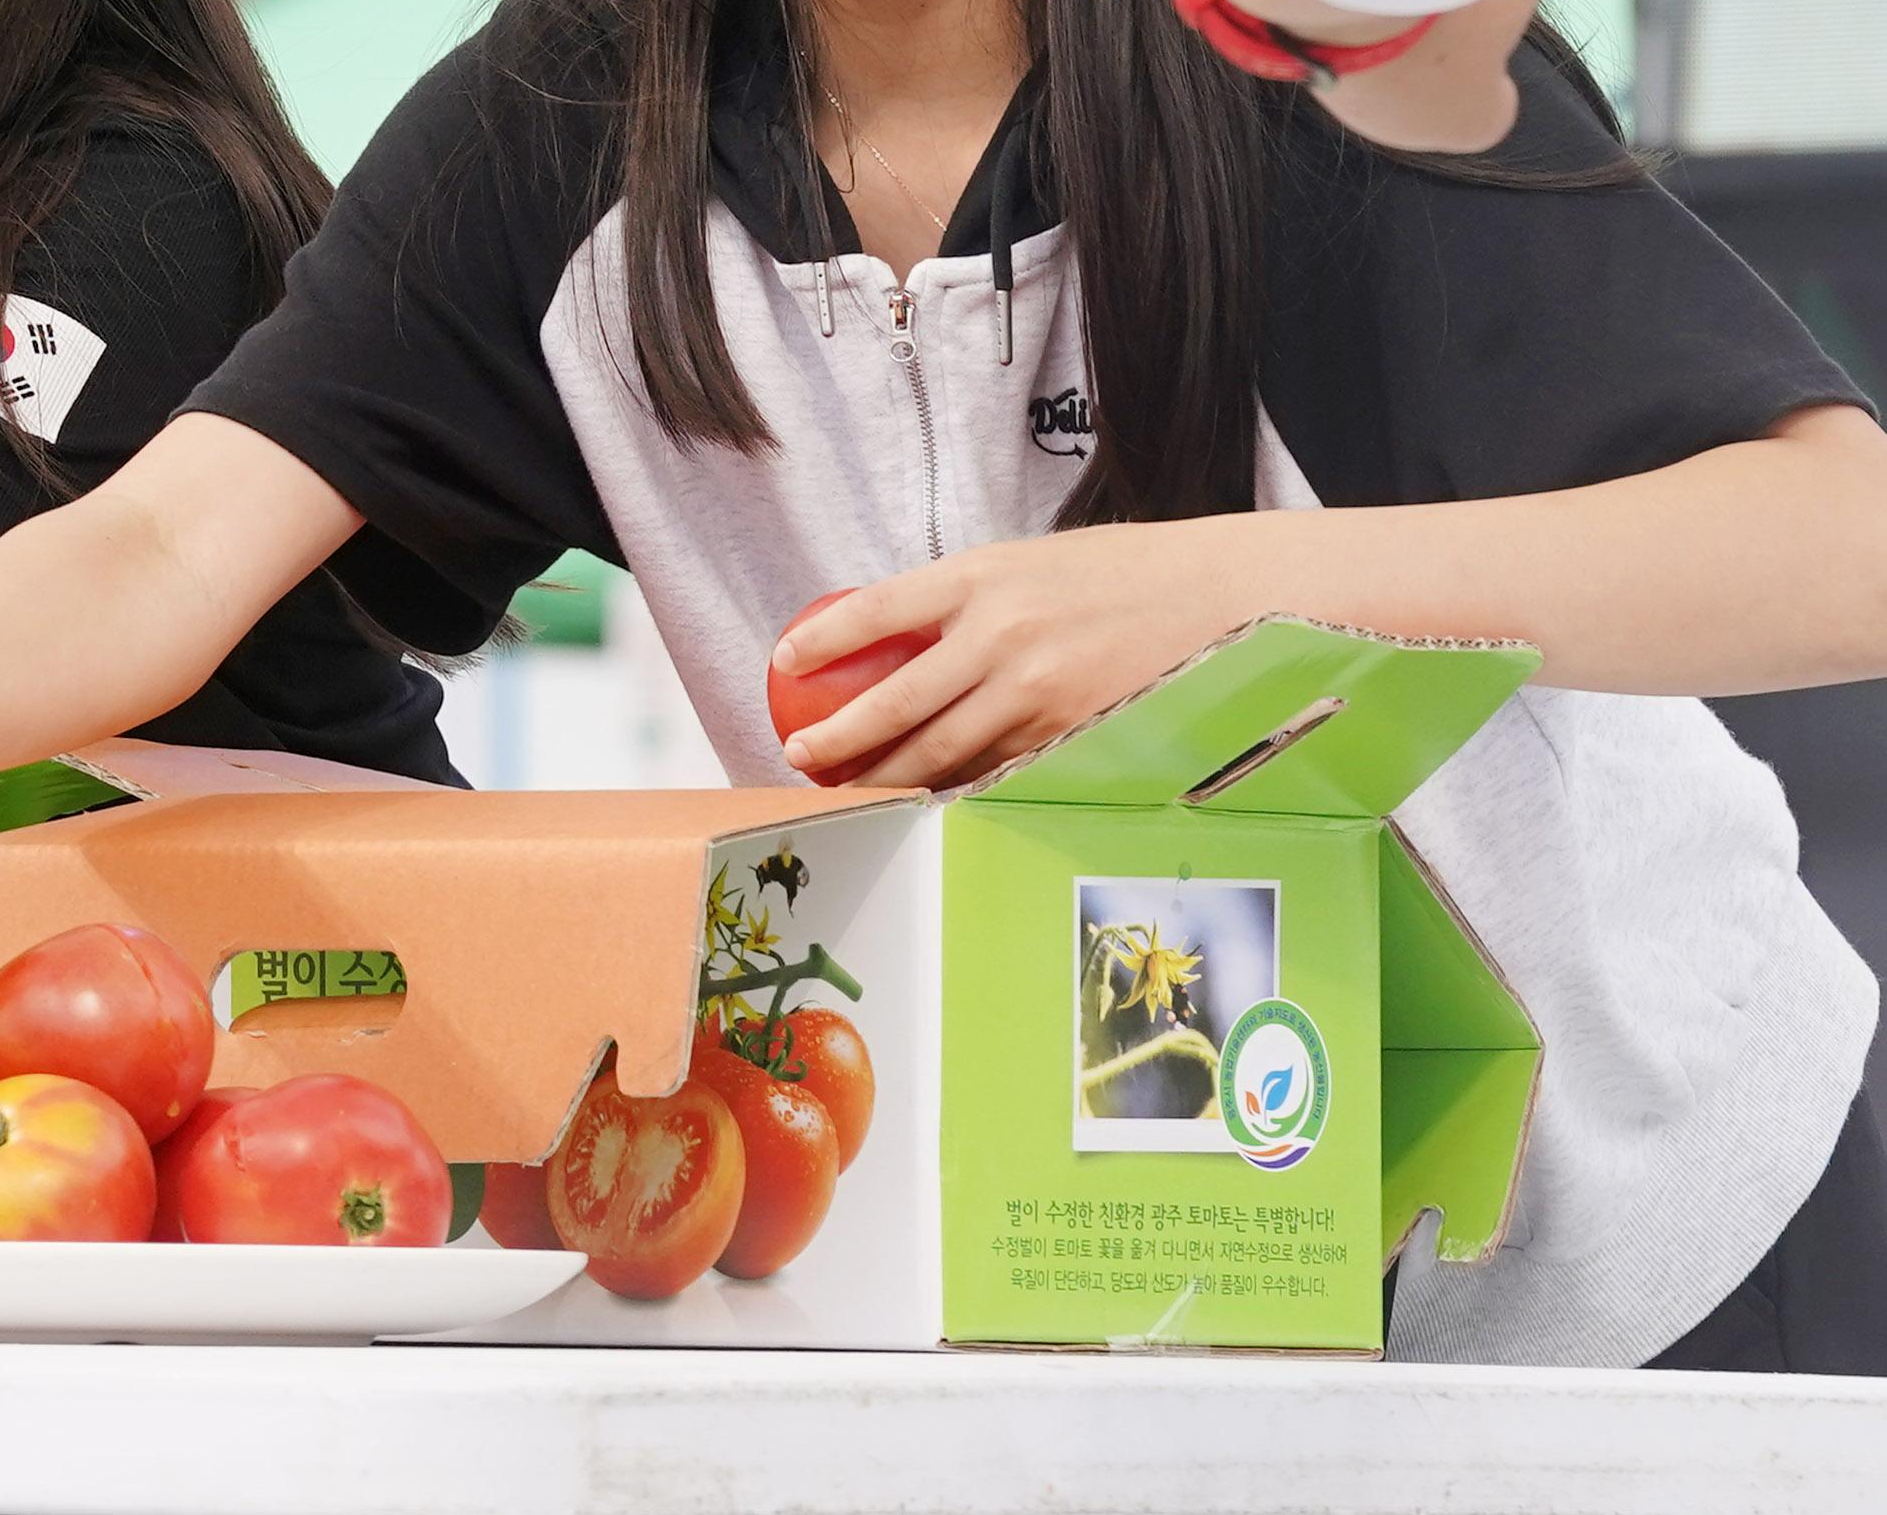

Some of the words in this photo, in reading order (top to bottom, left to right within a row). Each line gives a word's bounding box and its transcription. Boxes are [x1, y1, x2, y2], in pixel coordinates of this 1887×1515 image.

[1007, 1199, 1039, 1227] 벌이
[1045, 1200, 1094, 1229] 수정한
[1099, 1202, 1145, 1231] 친환경
[1151, 1204, 1182, 1231] 광주
[1186, 1205, 1249, 1233] 토마토는
[1253, 1207, 1335, 1234] 특별합니다!
[991, 1236, 1047, 1258] 수정벌이
[1054, 1238, 1092, 1259] 토마토
[1098, 1237, 1124, 1259] 꽃을
[1130, 1238, 1157, 1260] 옮겨
[1162, 1239, 1215, 1261] 다니면서
[1219, 1241, 1294, 1264] 자연수정으로
[1299, 1243, 1347, 1265] 생산하여
[1011, 1268, 1050, 1291] 육질이
[1111, 1271, 1147, 1293] 당도와
[1153, 1272, 1187, 1293] 산도가
[1220, 1274, 1257, 1296] 품질이
[1261, 1275, 1329, 1297] 우수합니다.
